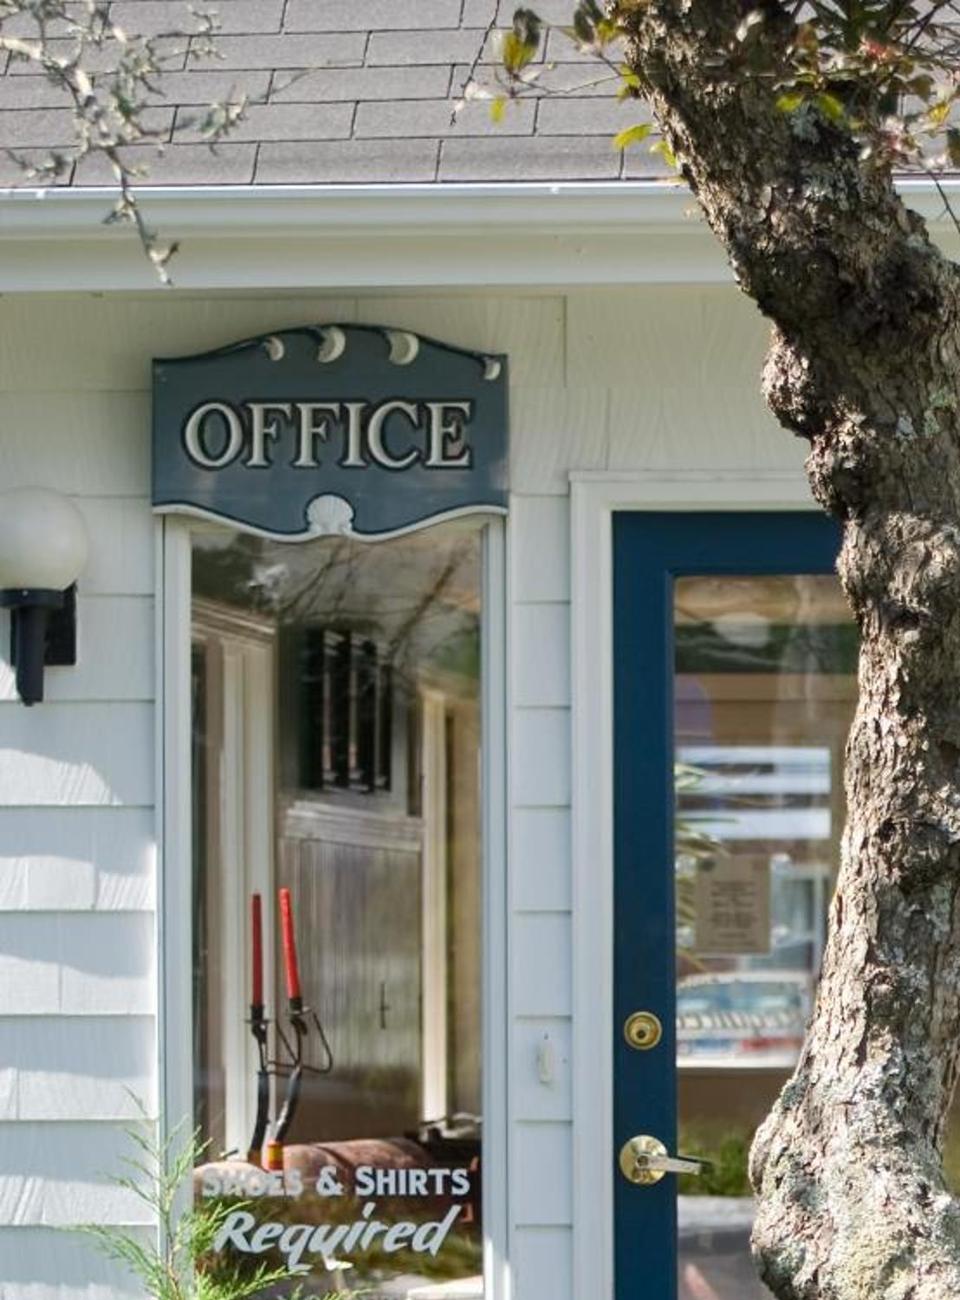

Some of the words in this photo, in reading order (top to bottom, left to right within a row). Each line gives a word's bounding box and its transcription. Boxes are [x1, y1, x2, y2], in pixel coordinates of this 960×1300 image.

[185, 401, 471, 467] OFFICE
[316, 1166, 344, 1196] &
[355, 1167, 471, 1196] SHIRTS
[213, 1202, 461, 1271] Required
